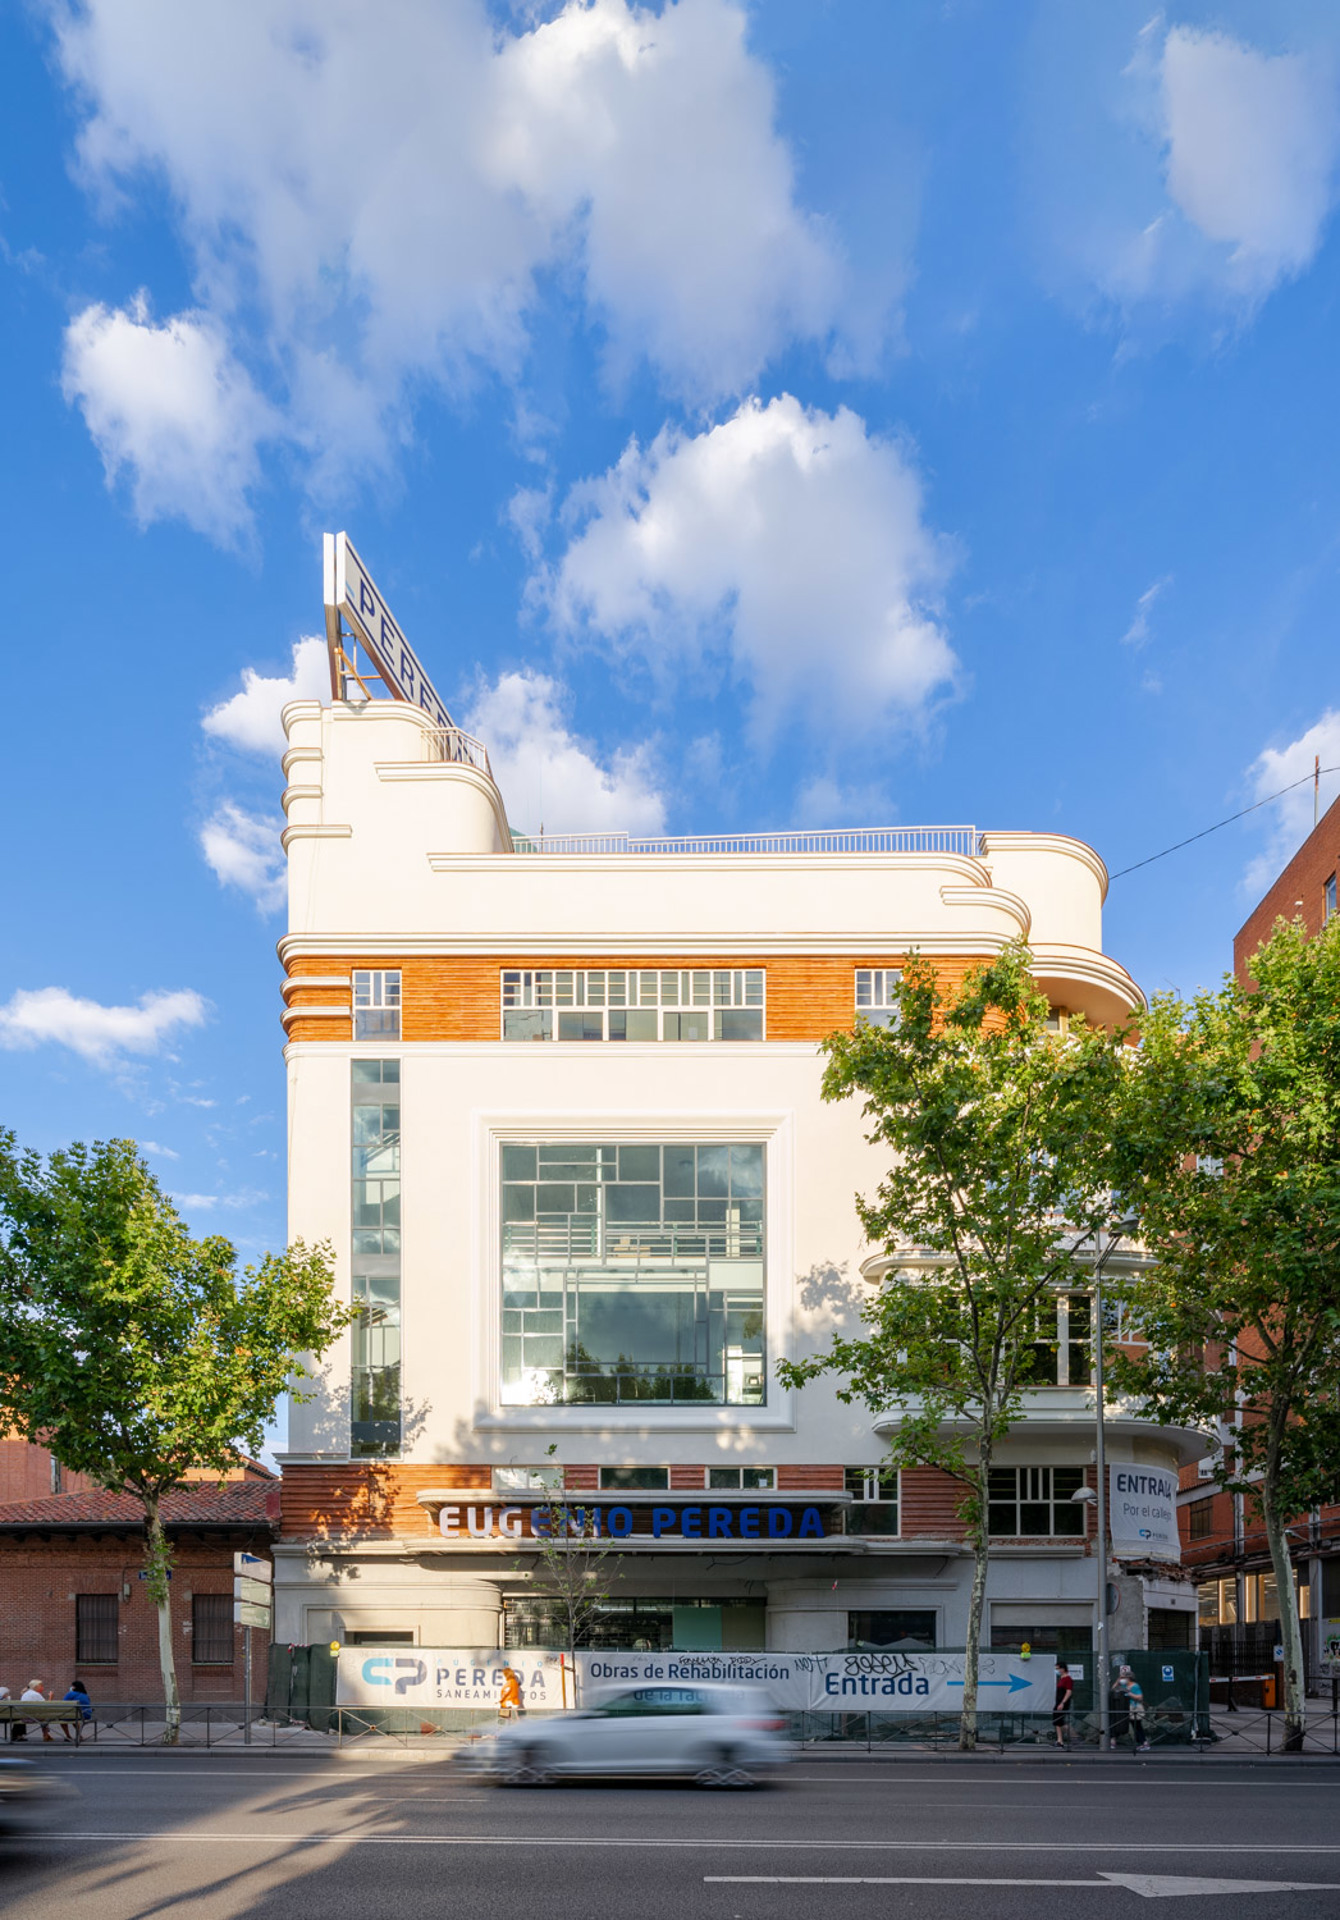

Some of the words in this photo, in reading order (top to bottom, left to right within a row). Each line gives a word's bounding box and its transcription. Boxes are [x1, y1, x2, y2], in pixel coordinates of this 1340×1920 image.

[1123, 1502, 1139, 1516] Por
[1142, 1505, 1150, 1518] el
[439, 1506, 633, 1538] EUGENIO
[652, 1507, 825, 1538] PEREDA
[590, 1663, 639, 1678] Obras
[644, 1663, 664, 1678] de
[668, 1663, 790, 1680] Rehabilitación
[825, 1673, 930, 1695] Entrada
[436, 1689, 547, 1700] SANEAMITOS
